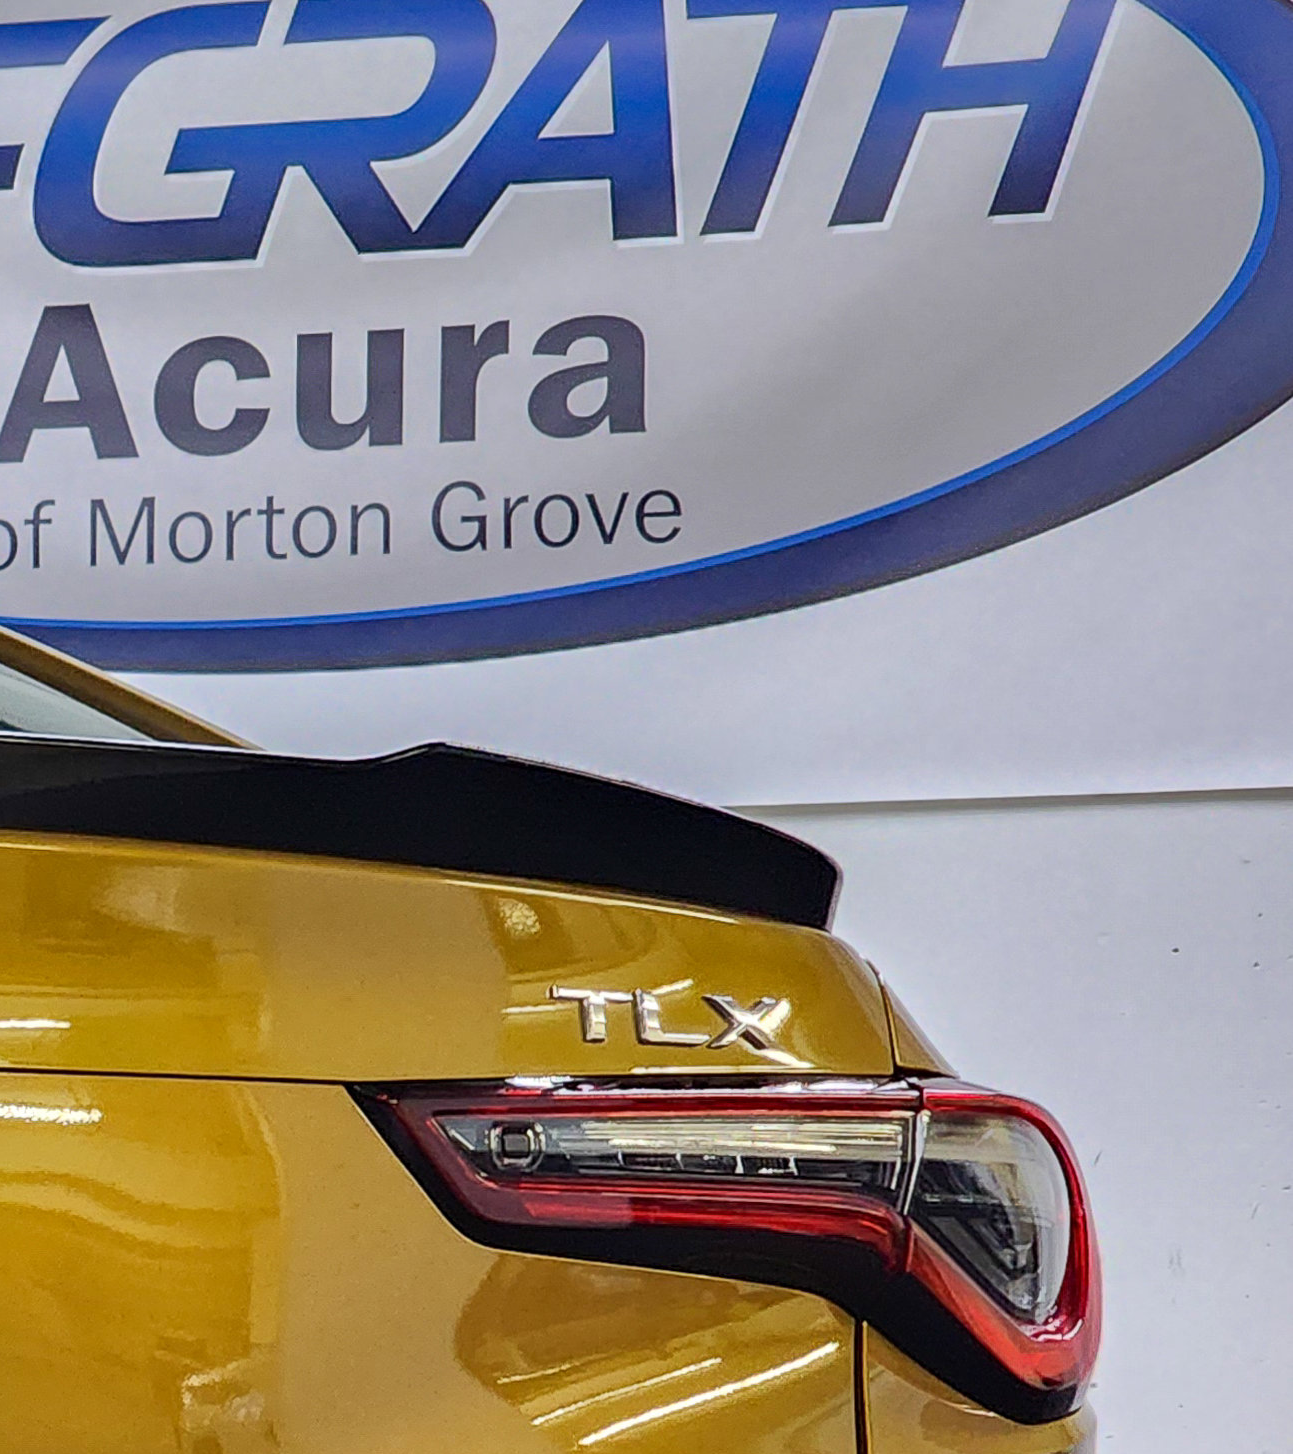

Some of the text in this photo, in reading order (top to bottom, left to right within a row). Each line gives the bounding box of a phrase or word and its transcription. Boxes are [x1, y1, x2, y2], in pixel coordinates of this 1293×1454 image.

[89, 495, 392, 567] Morton
[430, 480, 683, 552] Grove
[545, 983, 783, 1050] TLX
